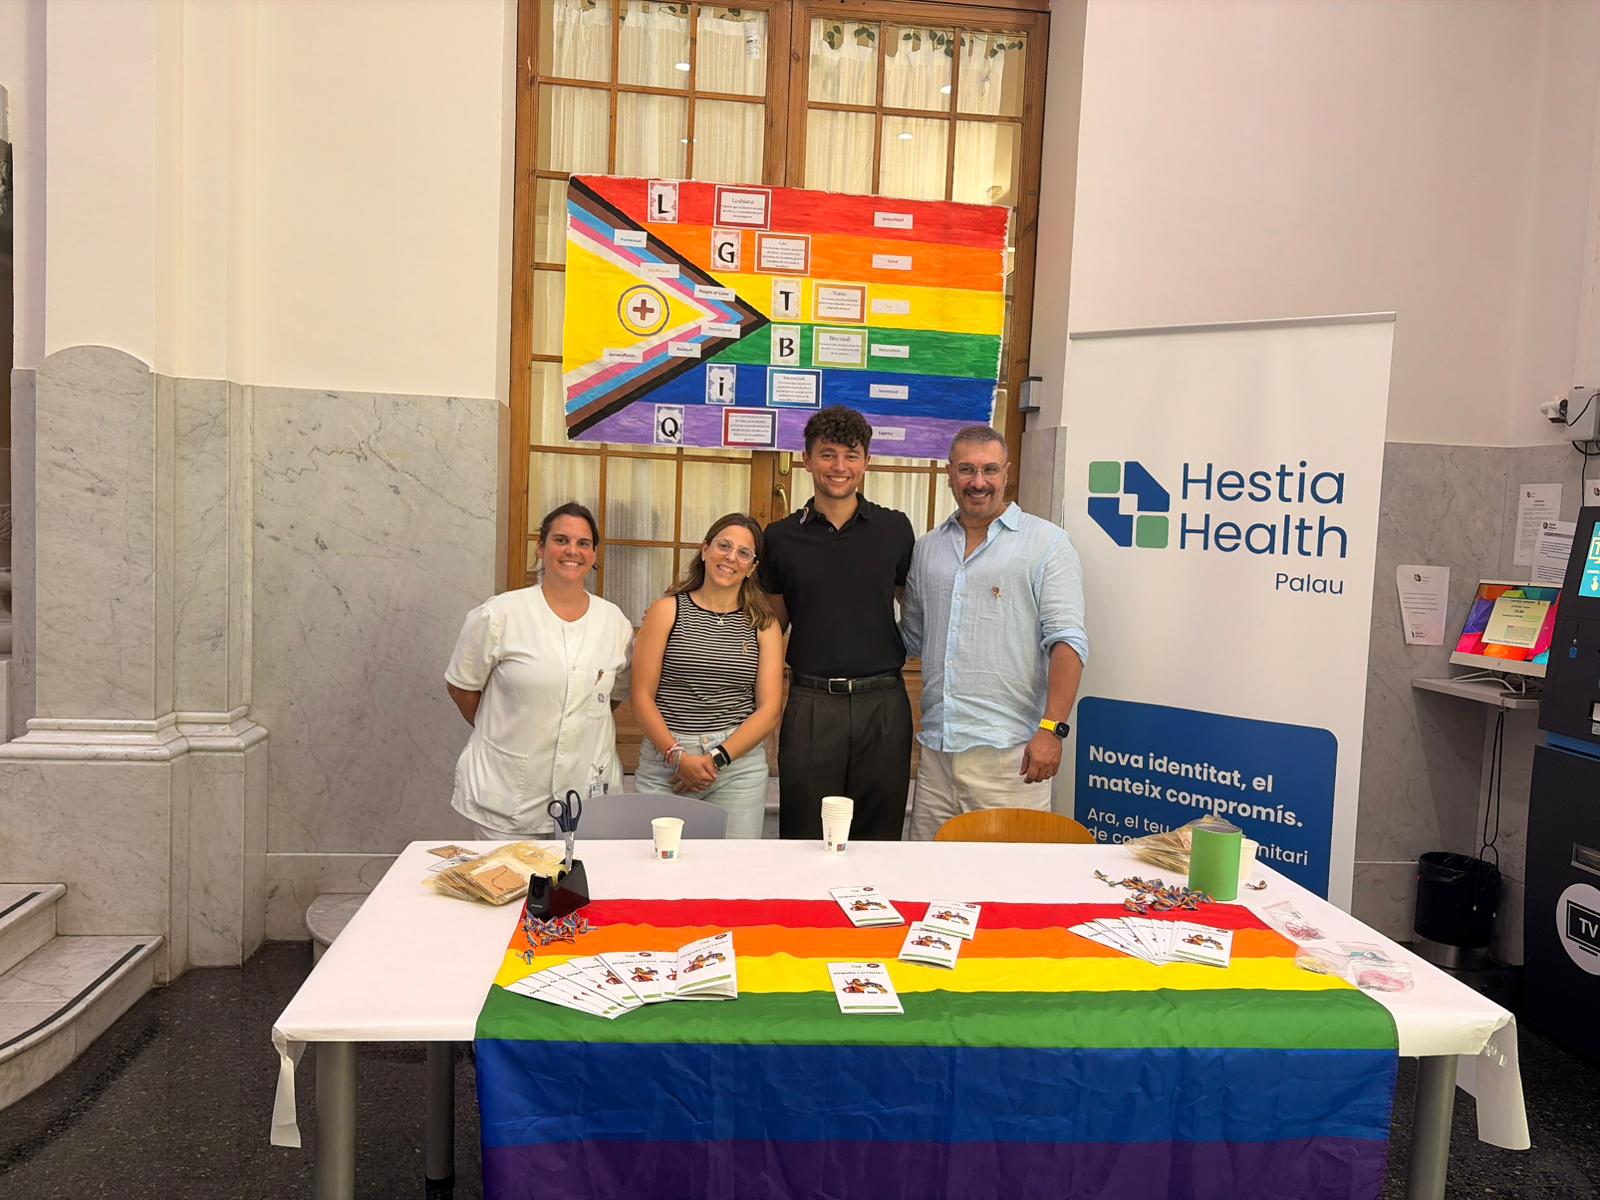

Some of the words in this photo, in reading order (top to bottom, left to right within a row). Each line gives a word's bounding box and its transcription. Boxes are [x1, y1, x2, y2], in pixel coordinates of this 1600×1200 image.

[658, 193, 670, 214] L
[718, 241, 735, 263] G
[779, 290, 795, 311] T
[779, 337, 794, 358] B
[661, 416, 679, 440] Q
[1182, 460, 1345, 504] Hestia
[1180, 512, 1347, 558] Health
[1275, 573, 1344, 595] Palau
[1089, 745, 1144, 769] Nova
[1149, 752, 1246, 791] identitat,
[1252, 774, 1273, 793] el
[1088, 773, 1162, 800] mateix
[1166, 786, 1303, 828] compromís.
[1087, 807, 1120, 827] Ara,
[1124, 815, 1139, 829] el
[1143, 817, 1170, 834] teu
[1258, 843, 1309, 866] nitari
[1578, 917, 1599, 938] TV
